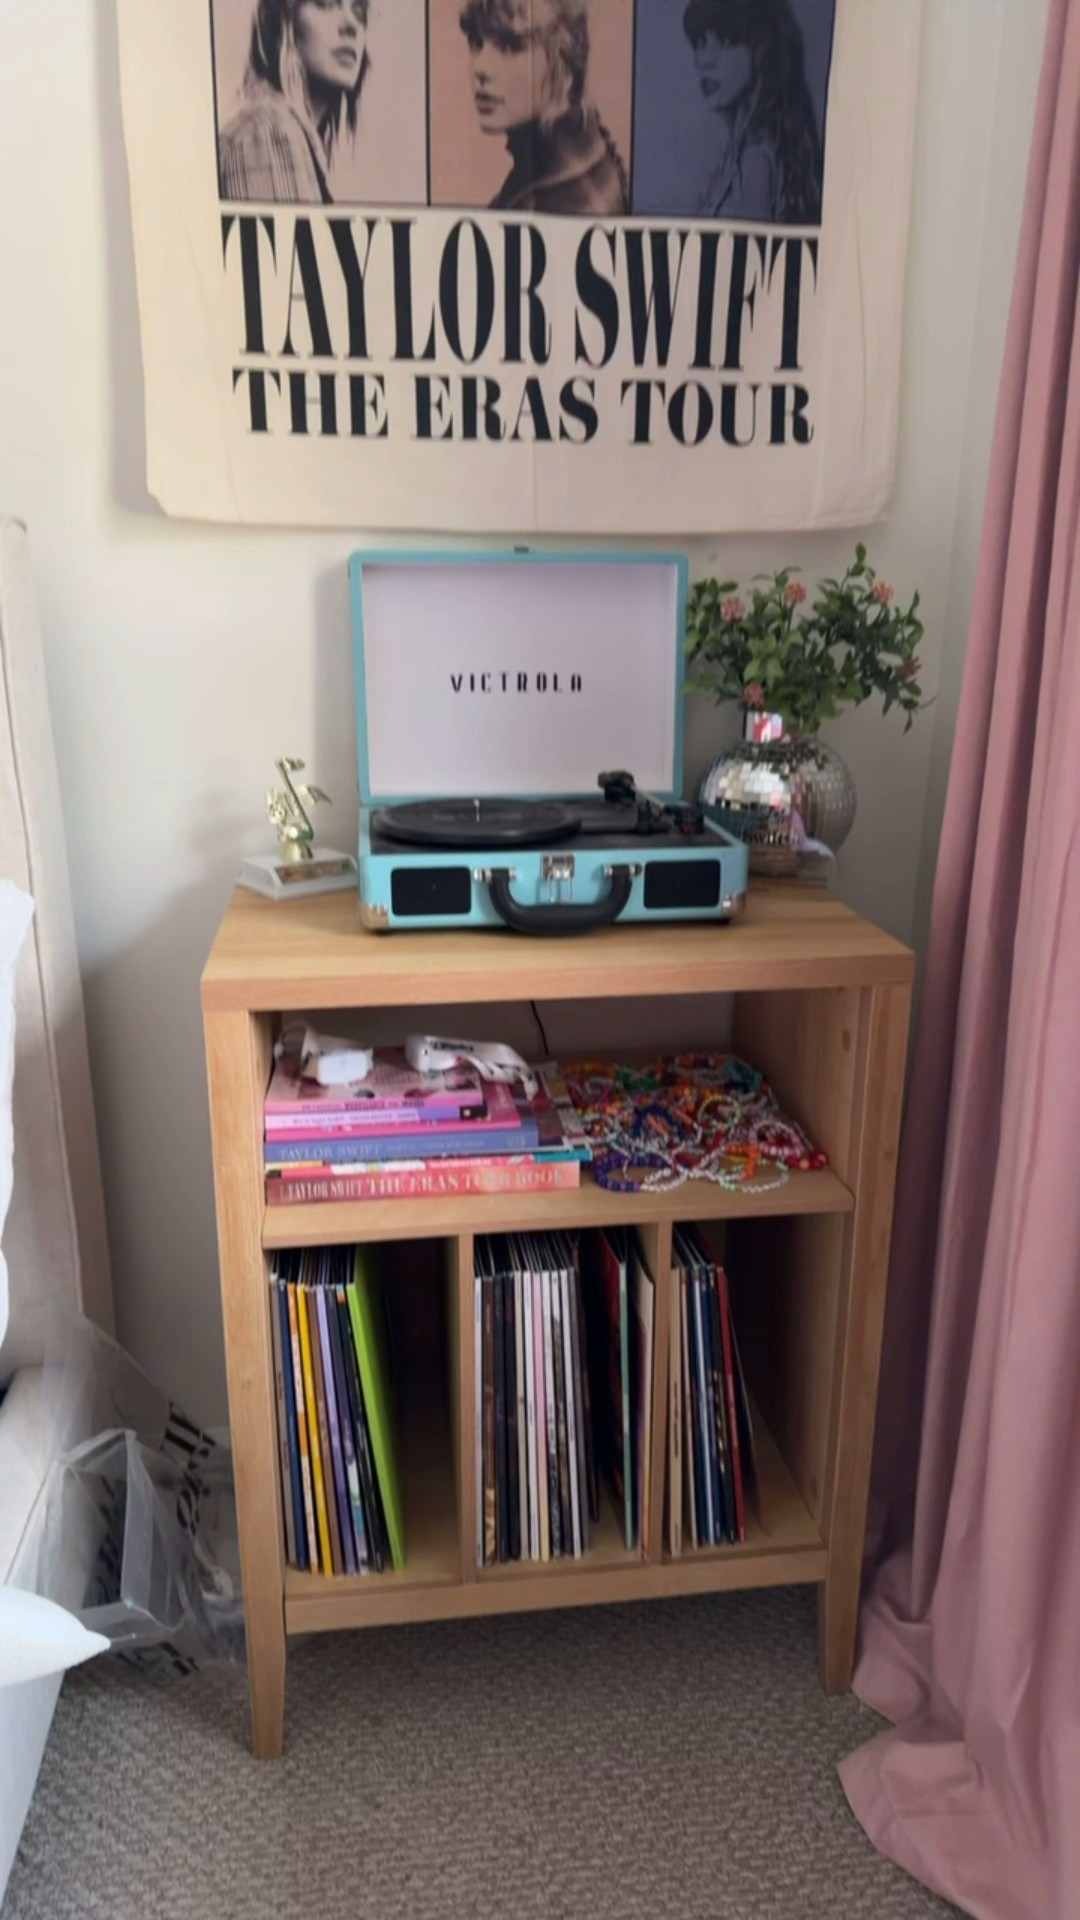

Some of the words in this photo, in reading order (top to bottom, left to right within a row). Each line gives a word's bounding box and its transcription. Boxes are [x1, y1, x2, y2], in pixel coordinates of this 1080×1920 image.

[220, 213, 552, 366] TAYLOR
[574, 224, 820, 372] SWIFT
[232, 367, 389, 438] THE
[411, 372, 600, 443] ERAS
[620, 379, 815, 448] TOUR
[450, 671, 582, 693] VICTROLA
[279, 1145, 333, 1161] TAYLOR
[337, 1143, 382, 1157] SWIFT
[285, 1180, 328, 1200] TAYLOR
[330, 1178, 362, 1198] SWIFT
[366, 1176, 404, 1196] THE
[408, 1172, 459, 1193] ERAS
[462, 1171, 512, 1191] TOUR
[515, 1168, 565, 1188] BOOK
